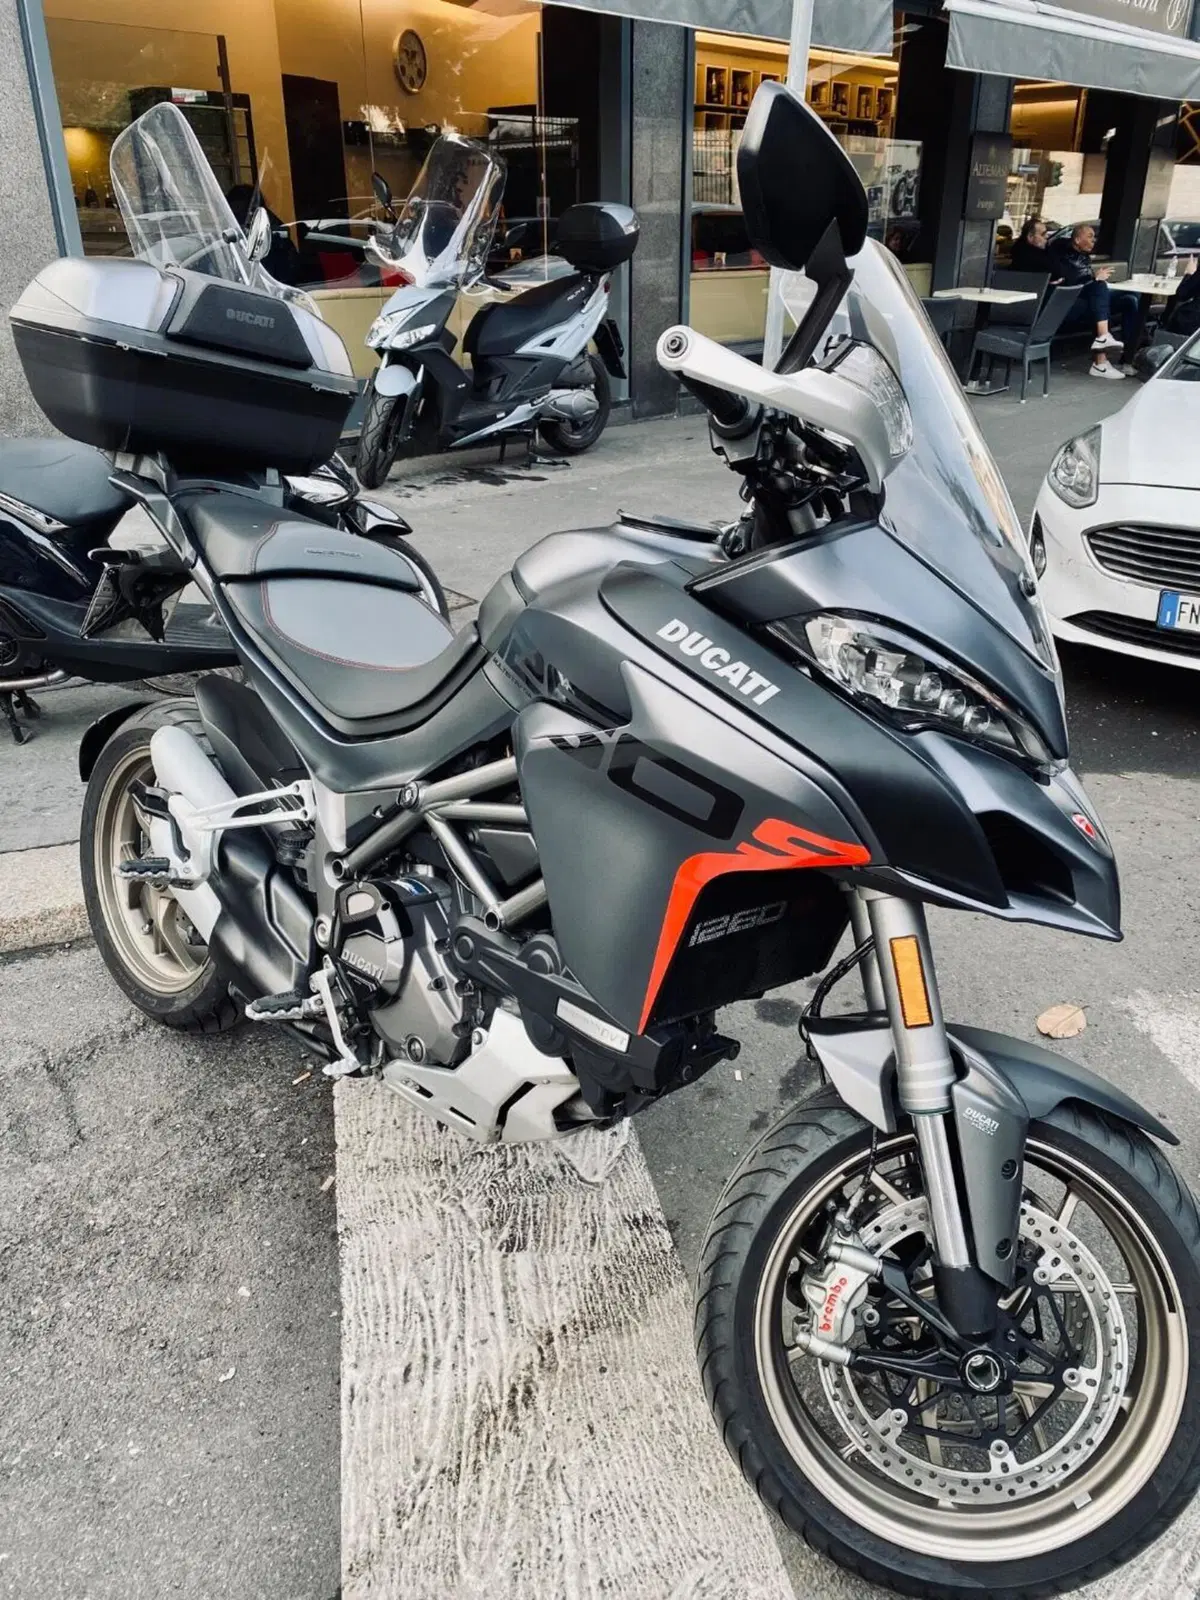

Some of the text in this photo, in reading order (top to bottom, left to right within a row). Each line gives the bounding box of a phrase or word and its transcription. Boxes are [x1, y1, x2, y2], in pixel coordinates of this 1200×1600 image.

[226, 308, 275, 329] DUCATI
[656, 618, 781, 705] DUCATI
[688, 900, 788, 948] 1260
[341, 949, 384, 980] DUCATI
[965, 1107, 999, 1130] DUCATI
[819, 1277, 848, 1332] brembo
